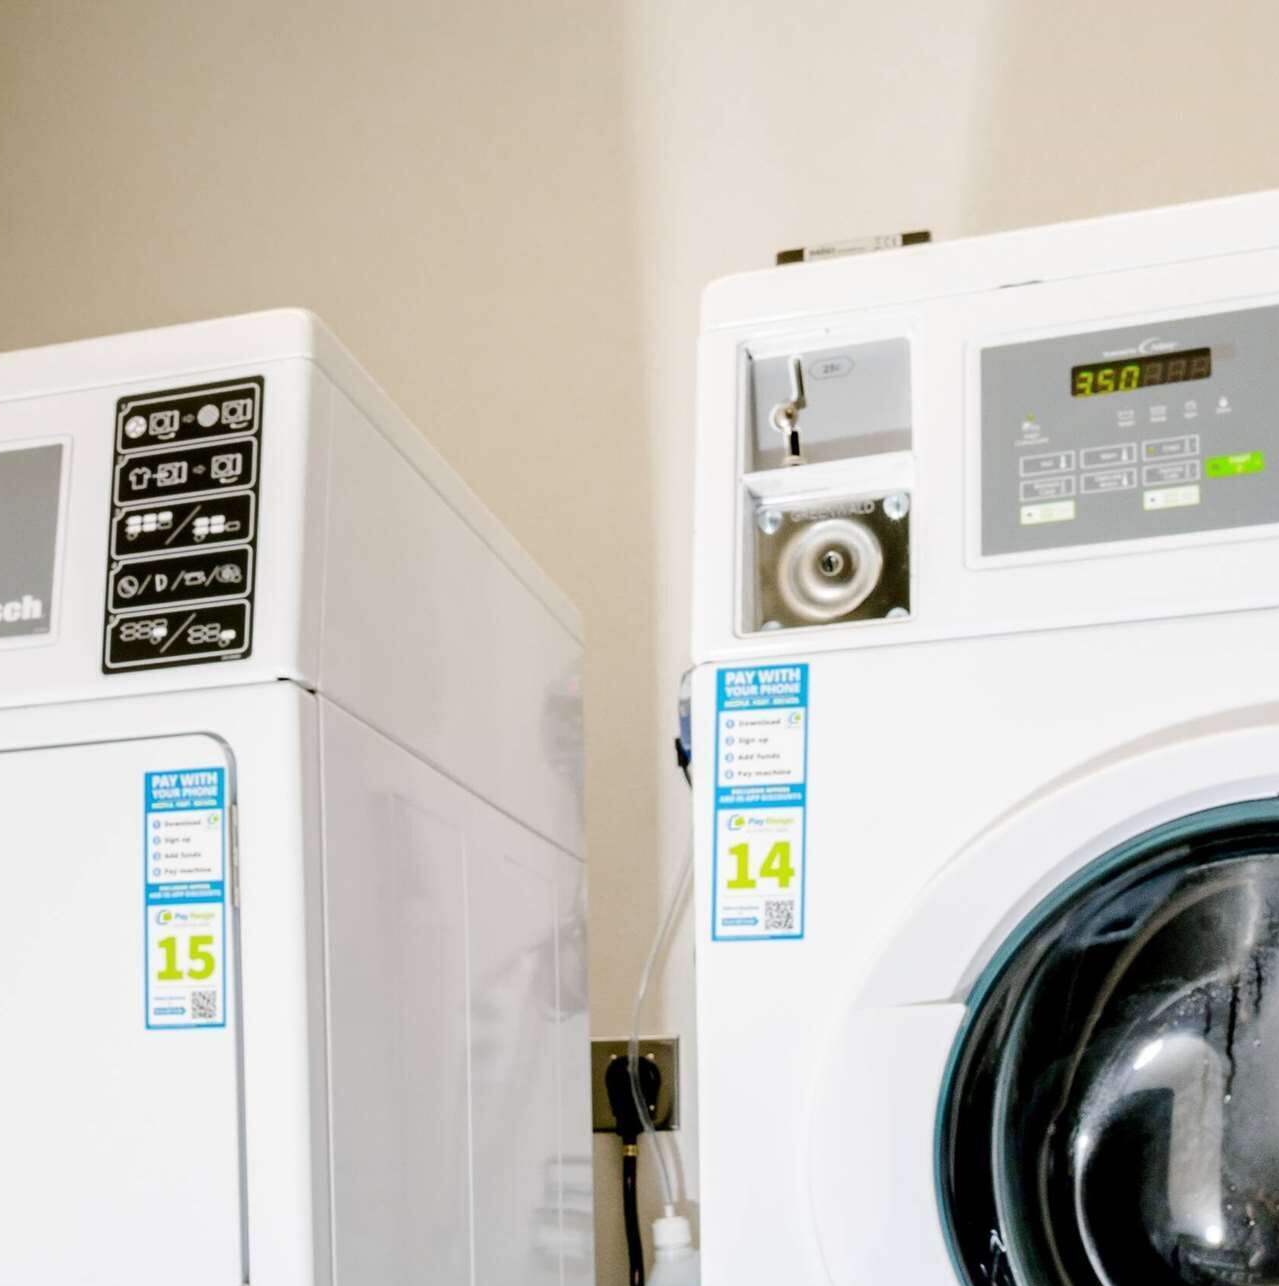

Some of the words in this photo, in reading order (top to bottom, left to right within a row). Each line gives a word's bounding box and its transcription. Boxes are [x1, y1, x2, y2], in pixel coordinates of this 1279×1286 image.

[1075, 364, 1140, 397] 350
[725, 670, 754, 686] PAY
[759, 667, 800, 683] WITH
[725, 685, 758, 698] YOUR
[761, 682, 800, 696] PHONE
[151, 774, 178, 789] PAY
[180, 771, 219, 787] WITH
[152, 788, 180, 800] YOUR
[182, 786, 218, 798] PHONE
[726, 840, 795, 890] 14
[157, 934, 216, 981] 15
